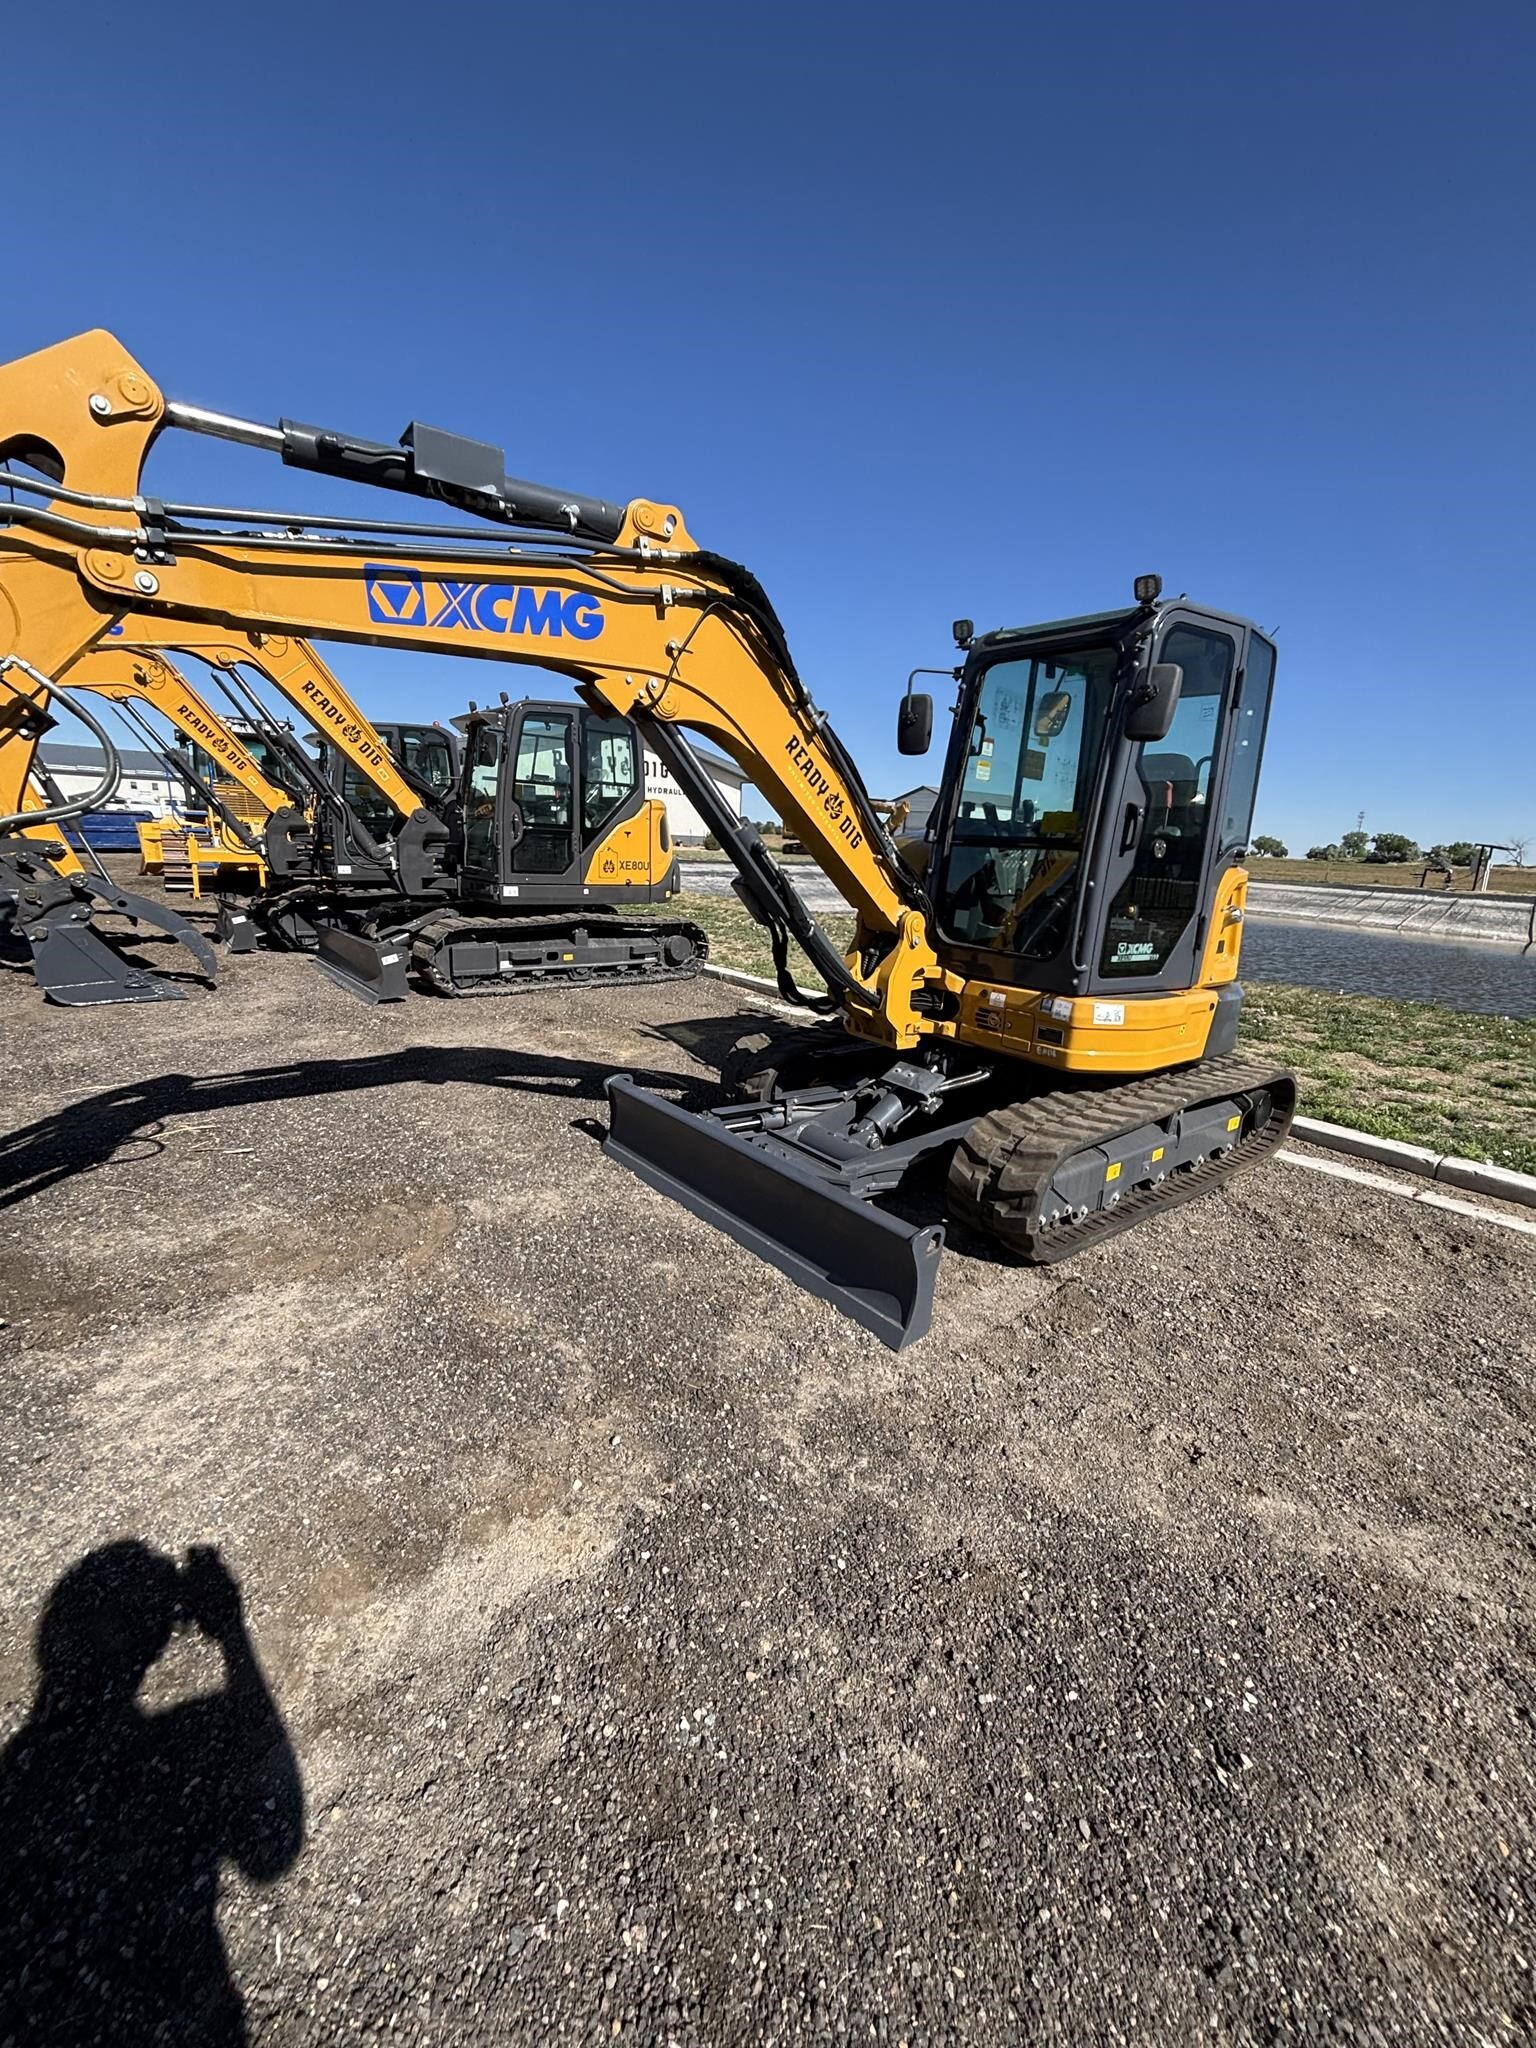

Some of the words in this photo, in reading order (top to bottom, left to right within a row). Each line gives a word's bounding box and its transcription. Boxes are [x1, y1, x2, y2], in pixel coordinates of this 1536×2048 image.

[428, 577, 605, 641] XCMG
[177, 704, 216, 739] READY
[226, 750, 248, 771] DIG
[301, 680, 347, 726] READY
[358, 740, 383, 767] DIG
[647, 786, 685, 796] HYDRAUL
[785, 734, 830, 797] READY
[838, 815, 863, 850] DIG
[619, 860, 650, 871] XE80U
[1126, 942, 1154, 955] XCMG
